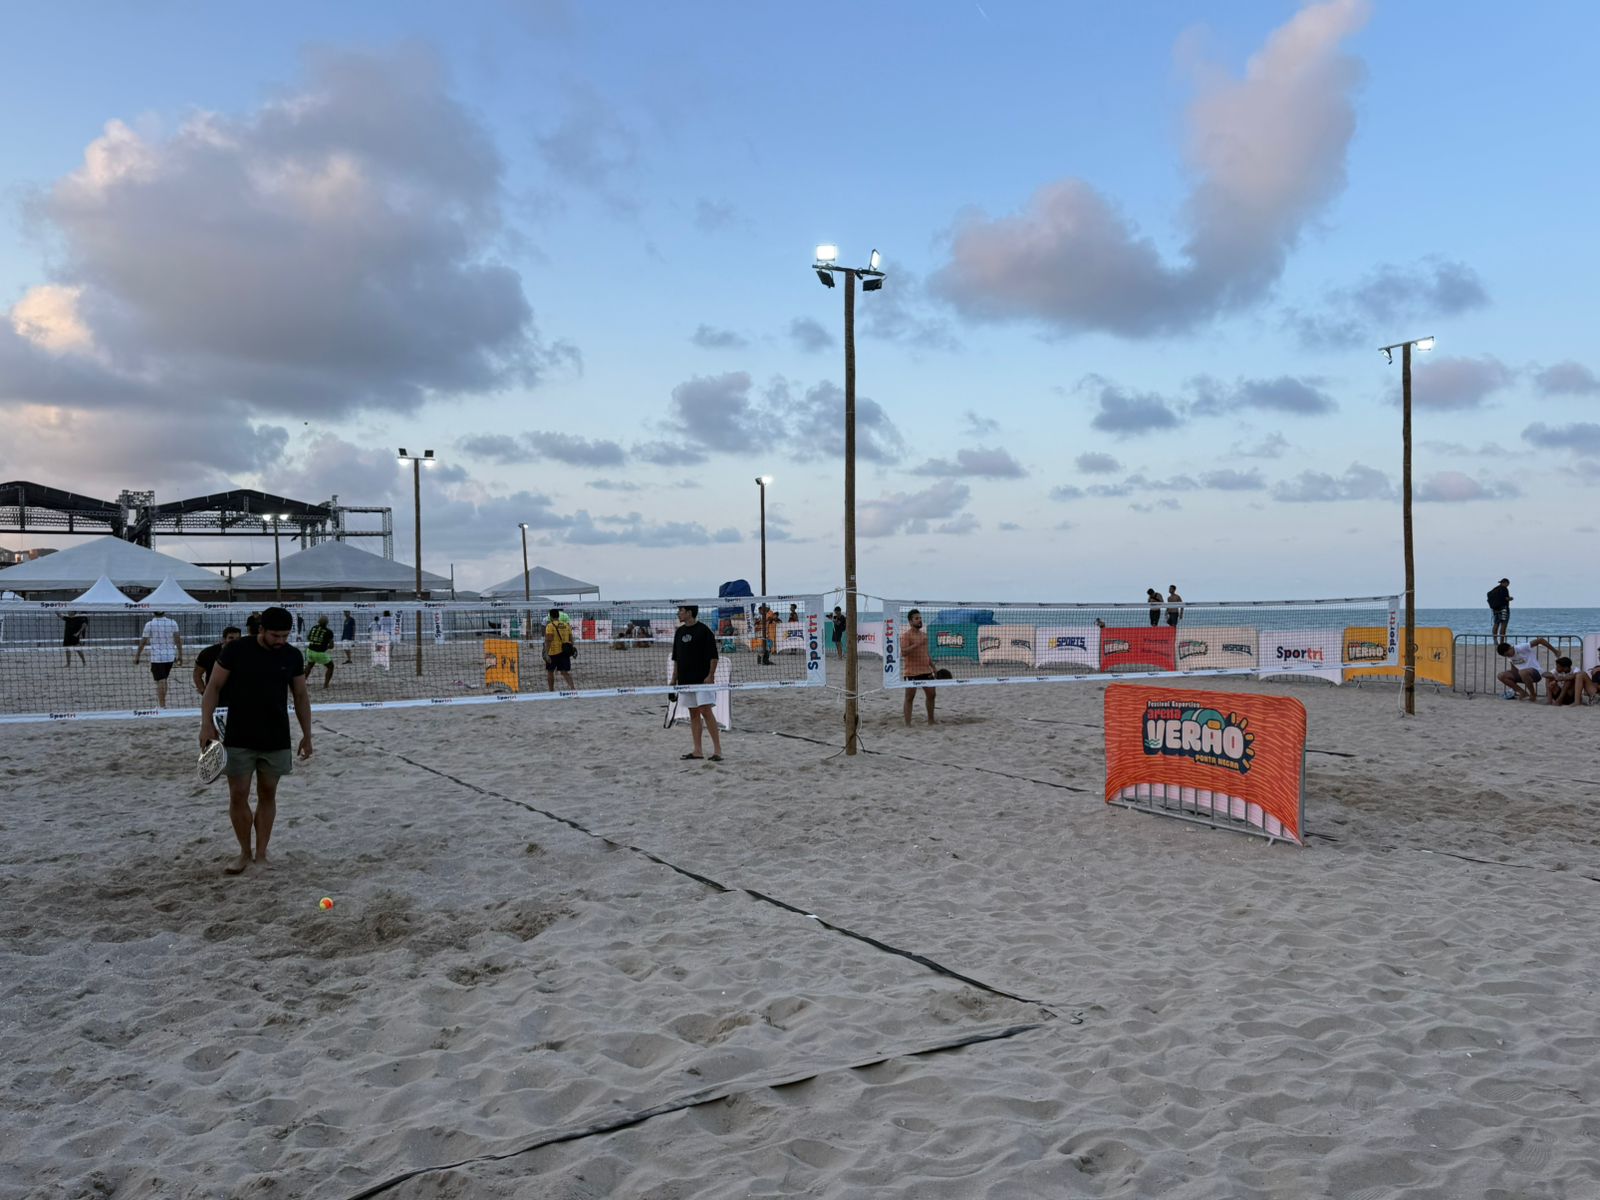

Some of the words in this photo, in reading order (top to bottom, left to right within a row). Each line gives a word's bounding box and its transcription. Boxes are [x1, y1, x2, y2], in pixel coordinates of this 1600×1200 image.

[807, 614, 821, 670] Sportri
[885, 618, 896, 673] Sportri
[1276, 646, 1323, 662] Sportri
[1388, 610, 1396, 654] Sportri
[1147, 708, 1182, 719] arena
